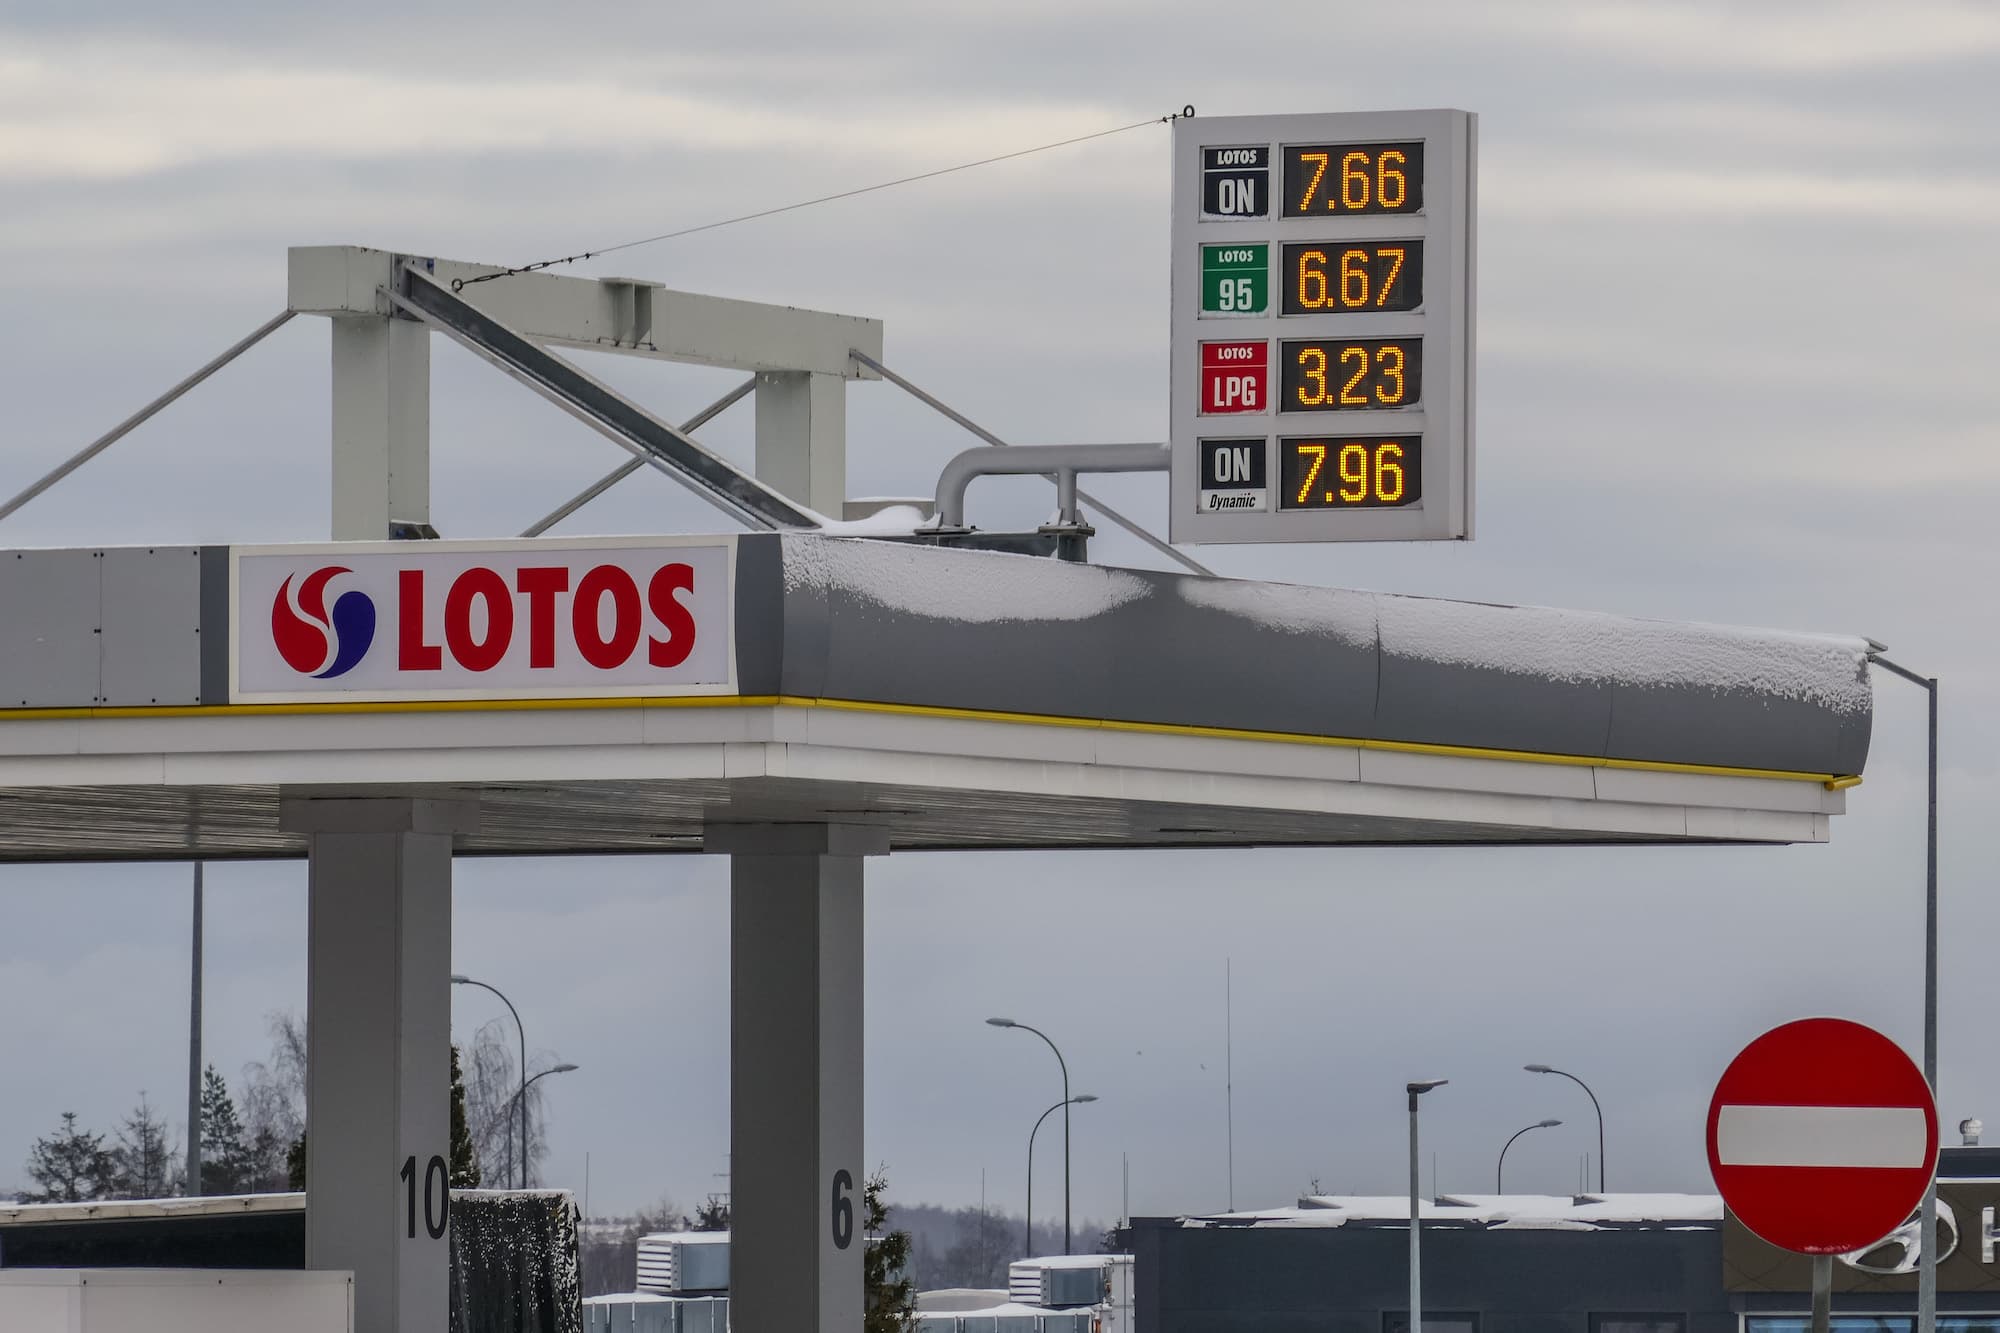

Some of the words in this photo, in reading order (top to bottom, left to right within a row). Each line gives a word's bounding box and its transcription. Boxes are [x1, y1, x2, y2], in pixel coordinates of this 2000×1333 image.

[1217, 150, 1257, 165] LOTOS
[1218, 179, 1255, 214] ON
[1299, 150, 1406, 211] 7.66
[1218, 249, 1254, 263] LOTOS
[1218, 278, 1253, 312] 95
[1299, 248, 1405, 309] 6.67
[1217, 346, 1253, 360] LOTOS
[1213, 376, 1257, 408] LPG
[1298, 346, 1404, 405] 3.23
[1214, 446, 1251, 483] ON
[1297, 443, 1404, 503] 7.96
[1208, 493, 1257, 511] Dynamic
[398, 563, 697, 672] LOTOS
[399, 1155, 449, 1240] 10
[831, 1168, 854, 1250] 6
